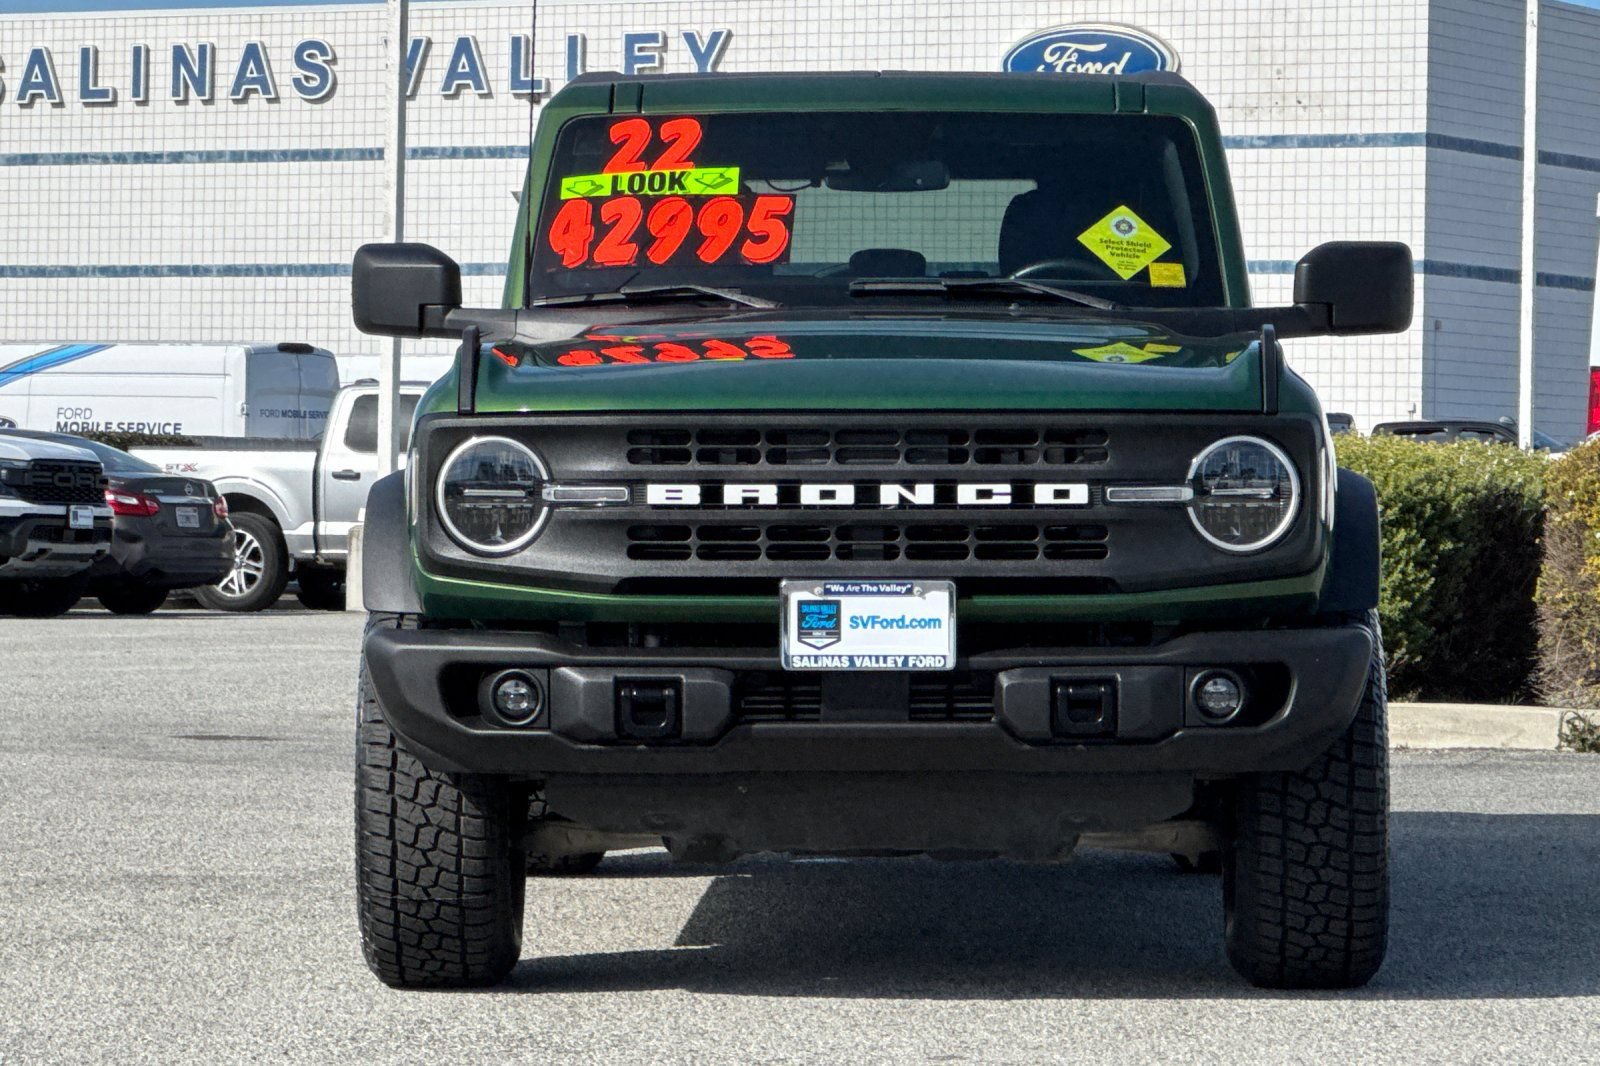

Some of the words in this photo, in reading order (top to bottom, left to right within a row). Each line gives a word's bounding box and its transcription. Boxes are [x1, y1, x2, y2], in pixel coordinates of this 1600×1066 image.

[0, 38, 336, 105] ALINAS
[602, 117, 702, 174] 22
[611, 172, 688, 194] LOOK
[549, 196, 793, 268] 42995
[1099, 238, 1125, 246] Select
[1126, 240, 1152, 248] Shield
[1105, 244, 1147, 253] Protected
[1110, 251, 1140, 259] Vehicle
[57, 408, 93, 420] FORD
[260, 409, 280, 418] FORD
[281, 409, 307, 419] MOBILE
[308, 410, 329, 419] SERVI
[56, 421, 114, 434] MOBILE
[117, 422, 183, 436] SERVICE
[647, 484, 1088, 505] BRONCO
[846, 584, 860, 593] Are
[861, 584, 878, 593] The
[802, 614, 837, 629] Ford
[850, 615, 942, 630] SVFord.com
[792, 656, 849, 668] SALINAS
[853, 656, 905, 668] VALLEY
[908, 656, 945, 668] FORD
